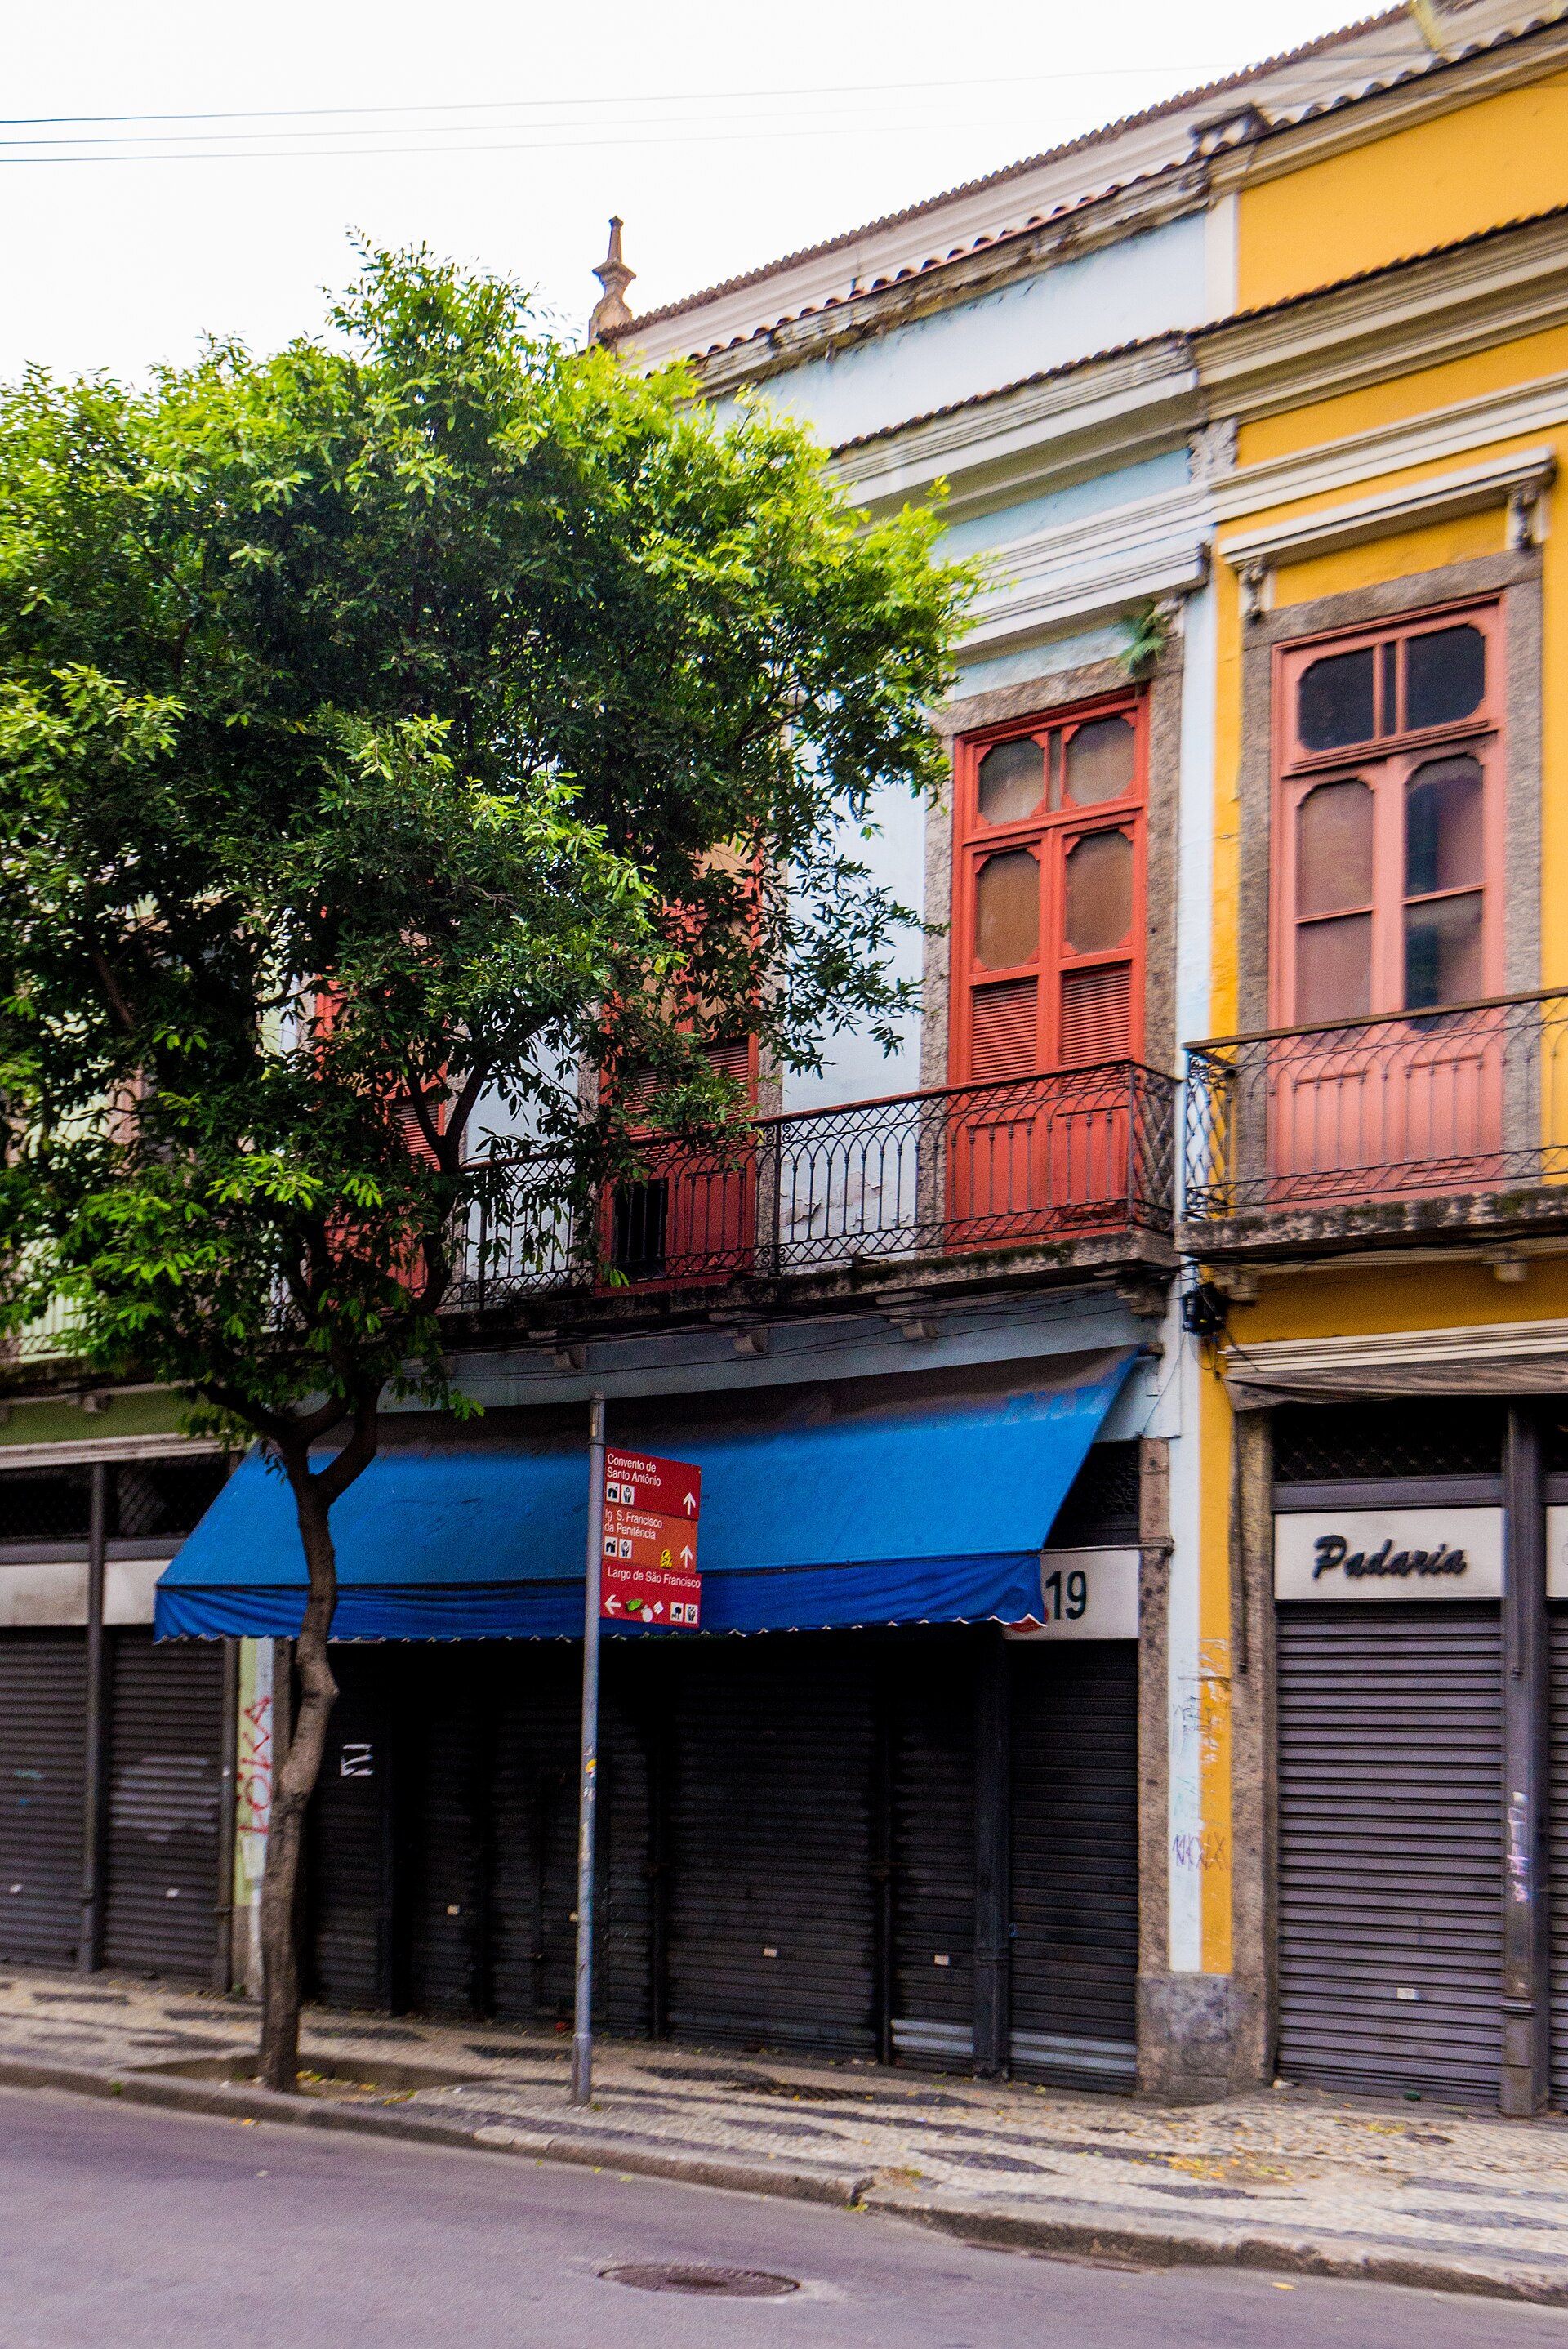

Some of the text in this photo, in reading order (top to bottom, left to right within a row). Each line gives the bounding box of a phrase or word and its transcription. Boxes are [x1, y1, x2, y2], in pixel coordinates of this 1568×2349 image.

[607, 1453, 657, 1473] Convento de
[607, 1466, 662, 1487] Santo Antônio
[617, 1509, 625, 1522] S.
[626, 1512, 662, 1528] Francisco
[604, 1522, 656, 1540] da Penitência
[1312, 1533, 1468, 1580] Padaria
[608, 1566, 702, 1589] Largo de São Francisco
[1045, 1570, 1087, 1620] 19
